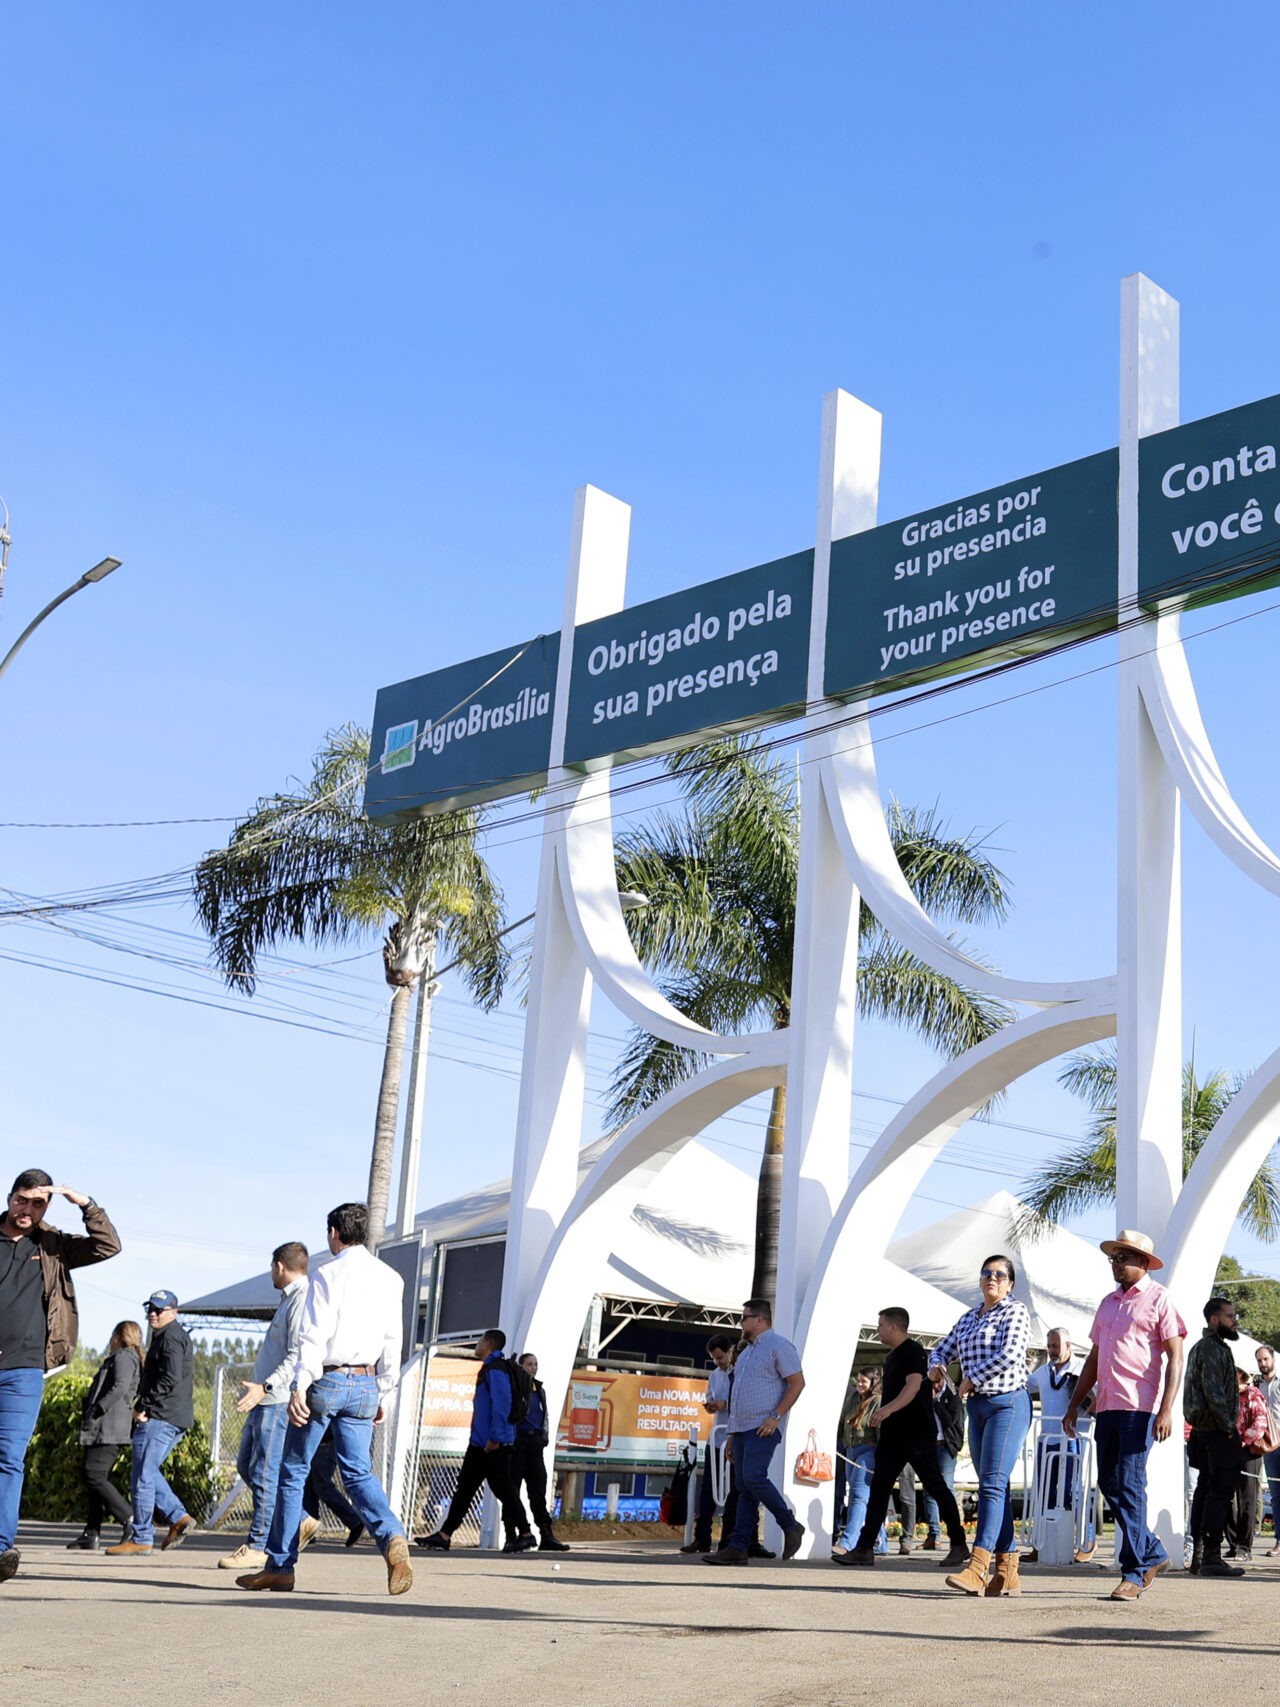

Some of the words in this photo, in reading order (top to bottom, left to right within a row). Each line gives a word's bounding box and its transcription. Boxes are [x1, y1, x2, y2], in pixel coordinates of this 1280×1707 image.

[894, 556, 920, 581] su
[927, 515, 1047, 576] presencia
[901, 503, 990, 547] Gracias
[997, 486, 1041, 523] por
[1171, 498, 1263, 554] você
[883, 590, 960, 632] Thank
[964, 578, 1011, 616] you
[1017, 564, 1055, 593] for
[587, 612, 720, 676] Obrigado
[727, 589, 792, 641] pela
[880, 632, 935, 671] your
[941, 598, 1056, 653] presence
[592, 690, 638, 724] sua
[646, 649, 779, 716] presença
[418, 686, 550, 755] AgroBrasília
[463, 1400, 474, 1412] S
[637, 1418, 701, 1432] RESULTADOS
[638, 1404, 660, 1415] para
[661, 1404, 699, 1417] grandes
[640, 1388, 661, 1399] Uma
[663, 1389, 691, 1402] NOVA
[692, 1391, 707, 1404] MA
